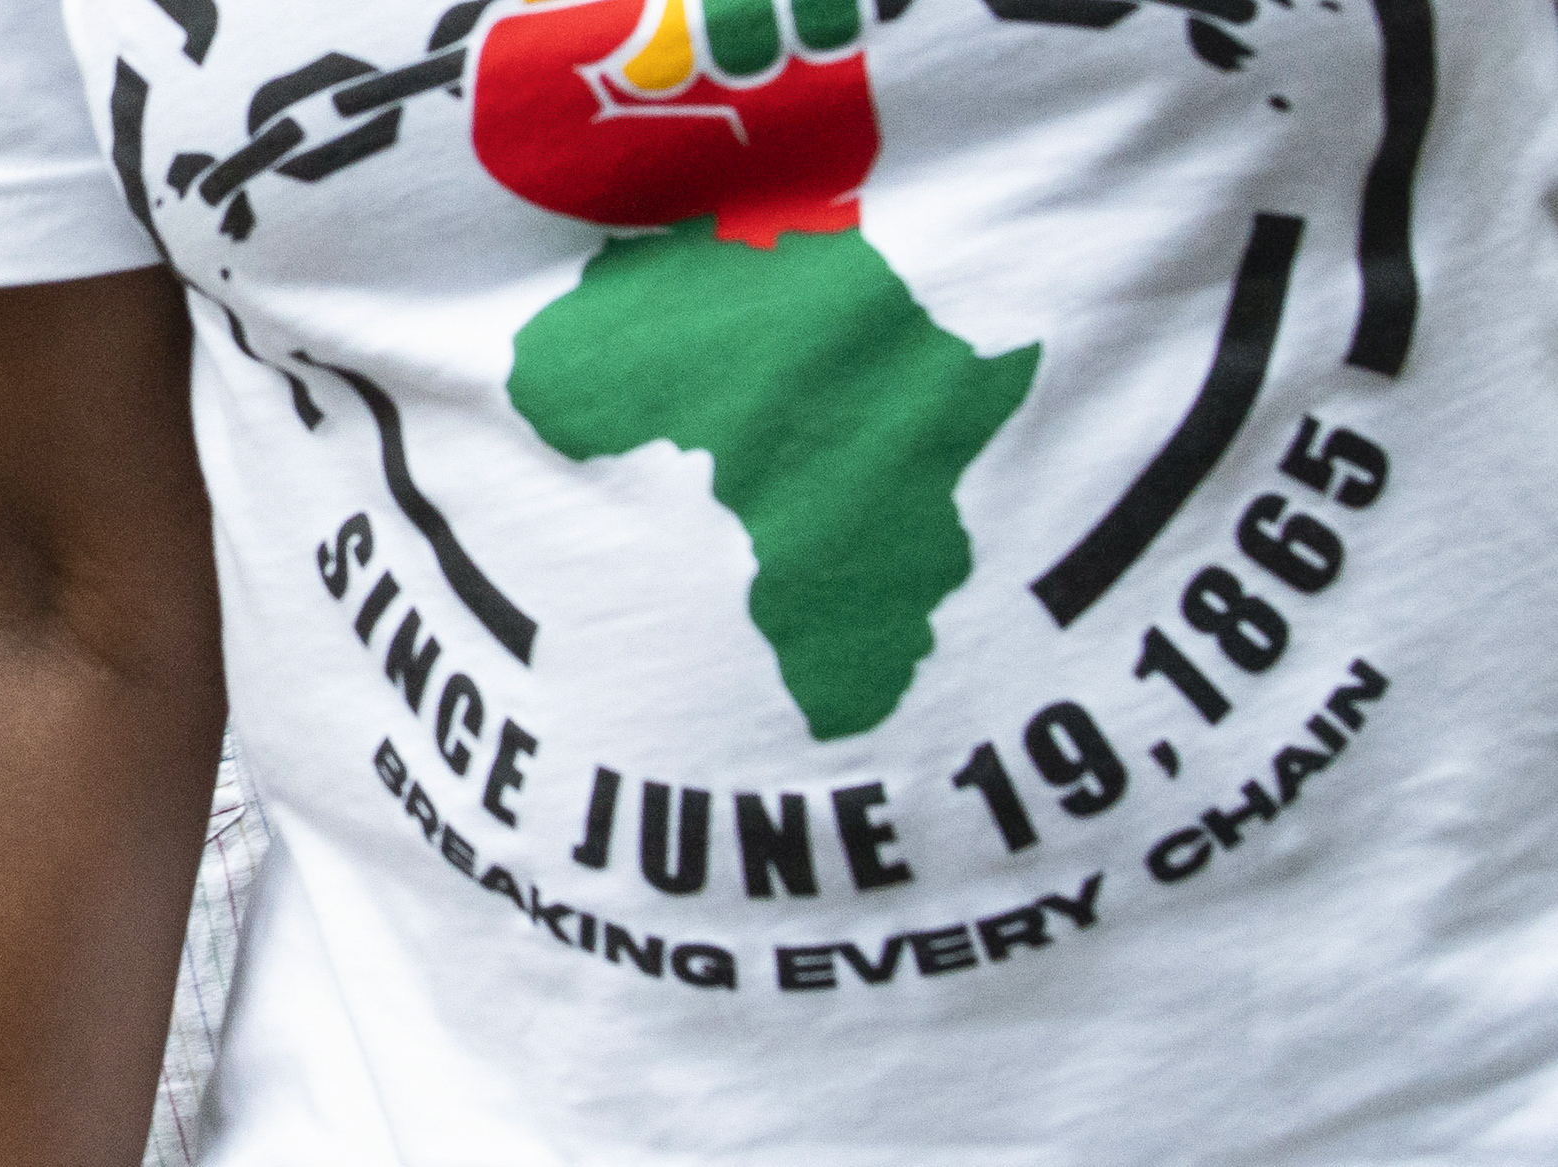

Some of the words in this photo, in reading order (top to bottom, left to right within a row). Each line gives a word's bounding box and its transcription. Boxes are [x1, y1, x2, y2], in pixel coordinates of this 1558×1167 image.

[316, 512, 538, 828] SINCE
[573, 766, 917, 901] JUNE
[373, 738, 739, 992] BREAKING
[775, 871, 1105, 994] EVERY
[1143, 658, 1391, 888] CHAIN
